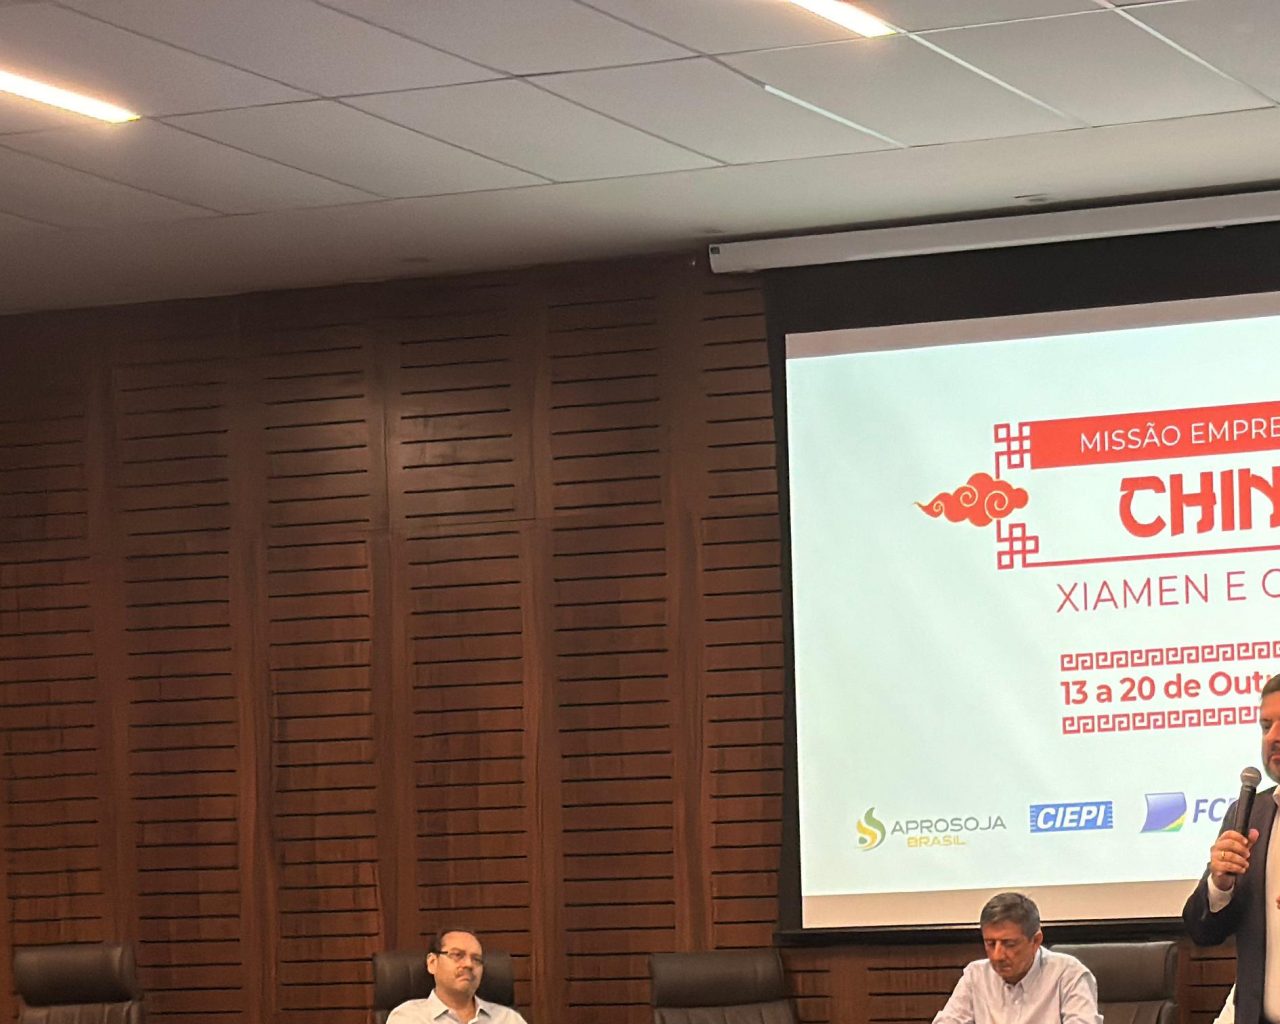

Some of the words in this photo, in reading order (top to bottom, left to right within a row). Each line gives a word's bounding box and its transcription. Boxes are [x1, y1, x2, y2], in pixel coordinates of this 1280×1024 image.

[1079, 421, 1182, 455] MISSÃO
[1056, 573, 1210, 614] XIAMEN
[1226, 570, 1248, 602] E
[1060, 679, 1089, 706] 13
[1096, 683, 1112, 704] a
[1119, 676, 1157, 703] 20
[1163, 668, 1202, 700] de
[890, 815, 1008, 836] APROSOJA
[1035, 804, 1106, 831] CIEPI
[906, 835, 967, 849] BRASIL
